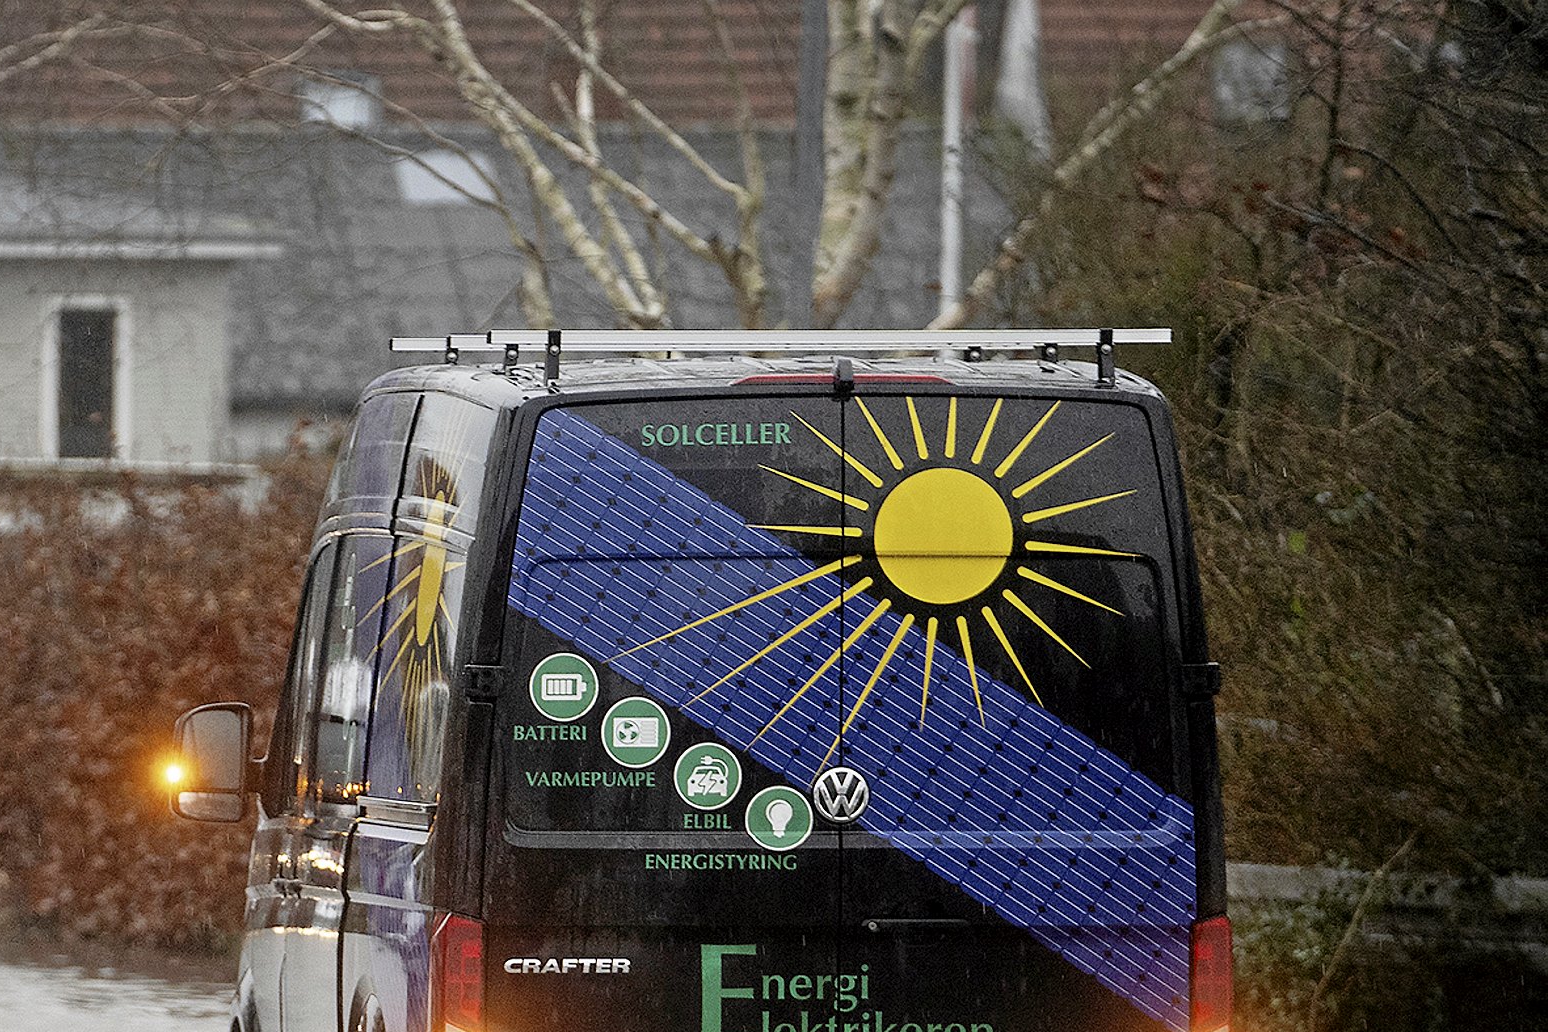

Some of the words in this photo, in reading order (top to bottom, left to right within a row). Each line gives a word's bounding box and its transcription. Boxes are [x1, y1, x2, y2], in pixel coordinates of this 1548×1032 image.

[641, 422, 792, 447] SOLCELLER
[513, 725, 587, 742] BATTERI
[525, 771, 656, 788] VARMEPUMPE
[683, 813, 732, 830] ELBIL
[645, 854, 797, 871] ENERGISTYRING
[503, 958, 631, 974] CRAFTER
